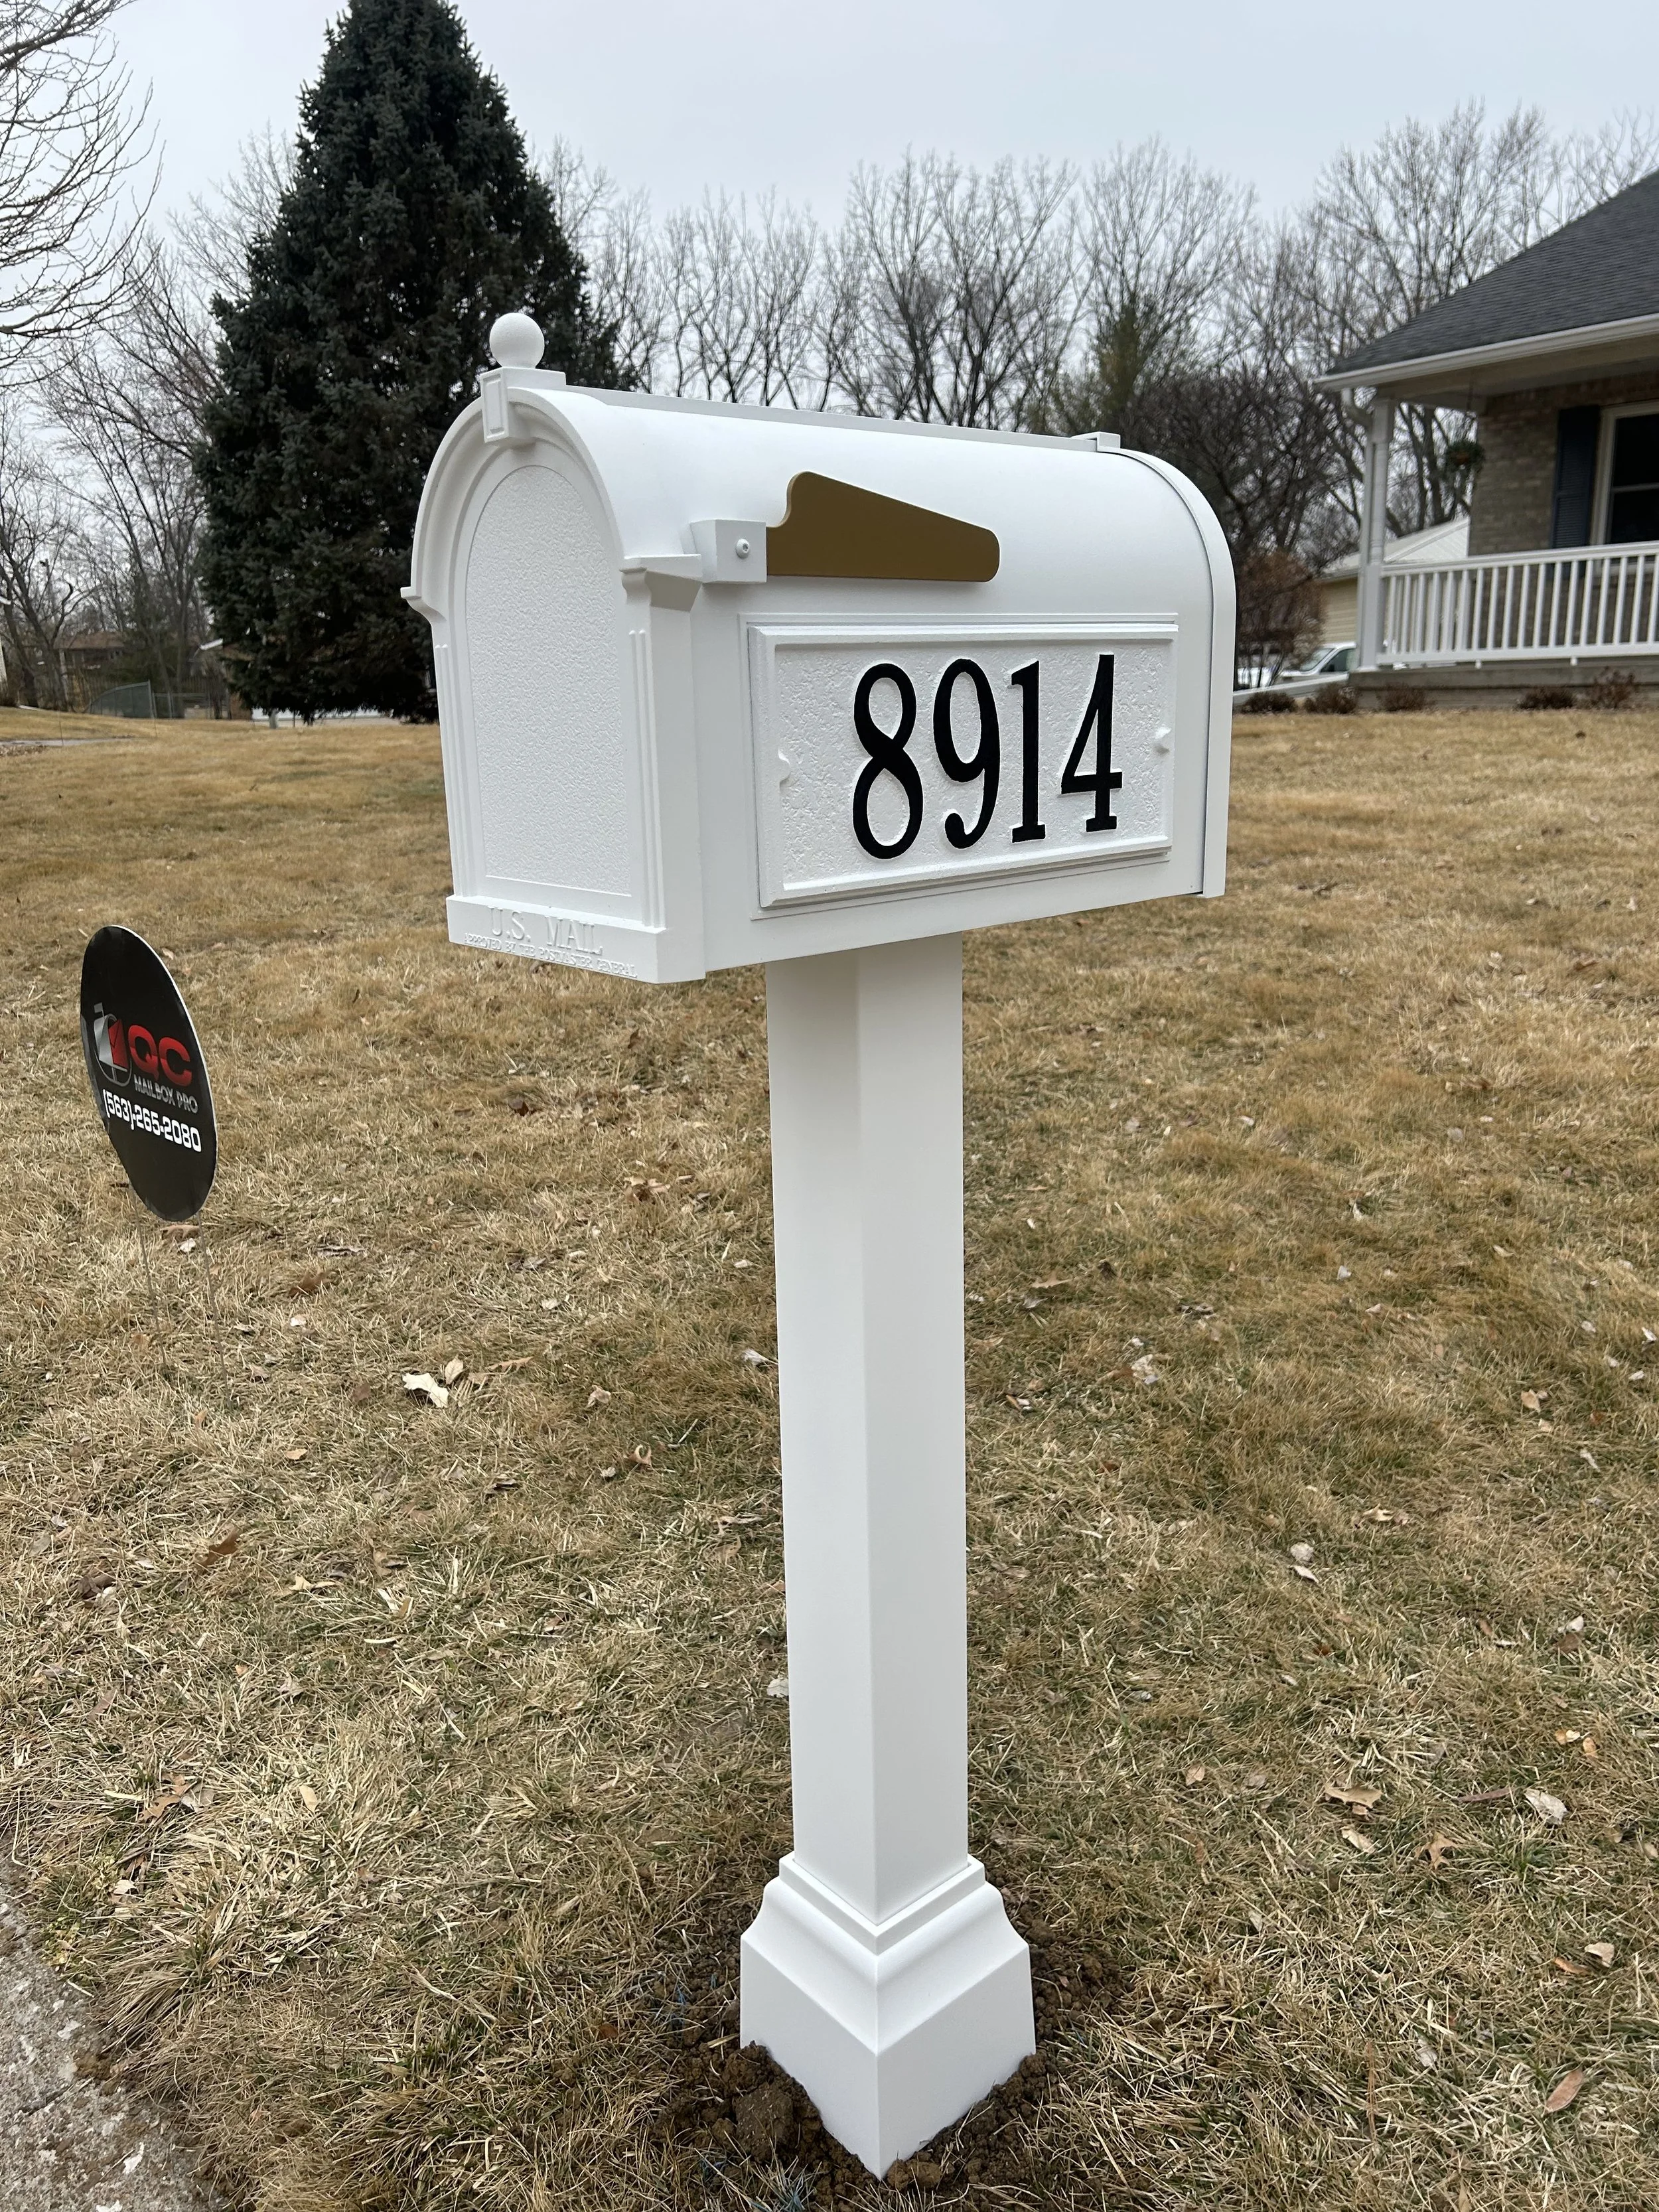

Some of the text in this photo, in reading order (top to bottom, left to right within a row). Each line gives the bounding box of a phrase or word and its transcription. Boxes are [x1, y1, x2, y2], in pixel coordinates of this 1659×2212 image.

[853, 654, 1123, 859] 8914
[488, 905, 603, 956] U.S. MAIL
[128, 1025, 192, 1086] QC
[103, 1088, 202, 1153] (563)-265-2080
[134, 1074, 198, 1114] MAILBOX PRO
